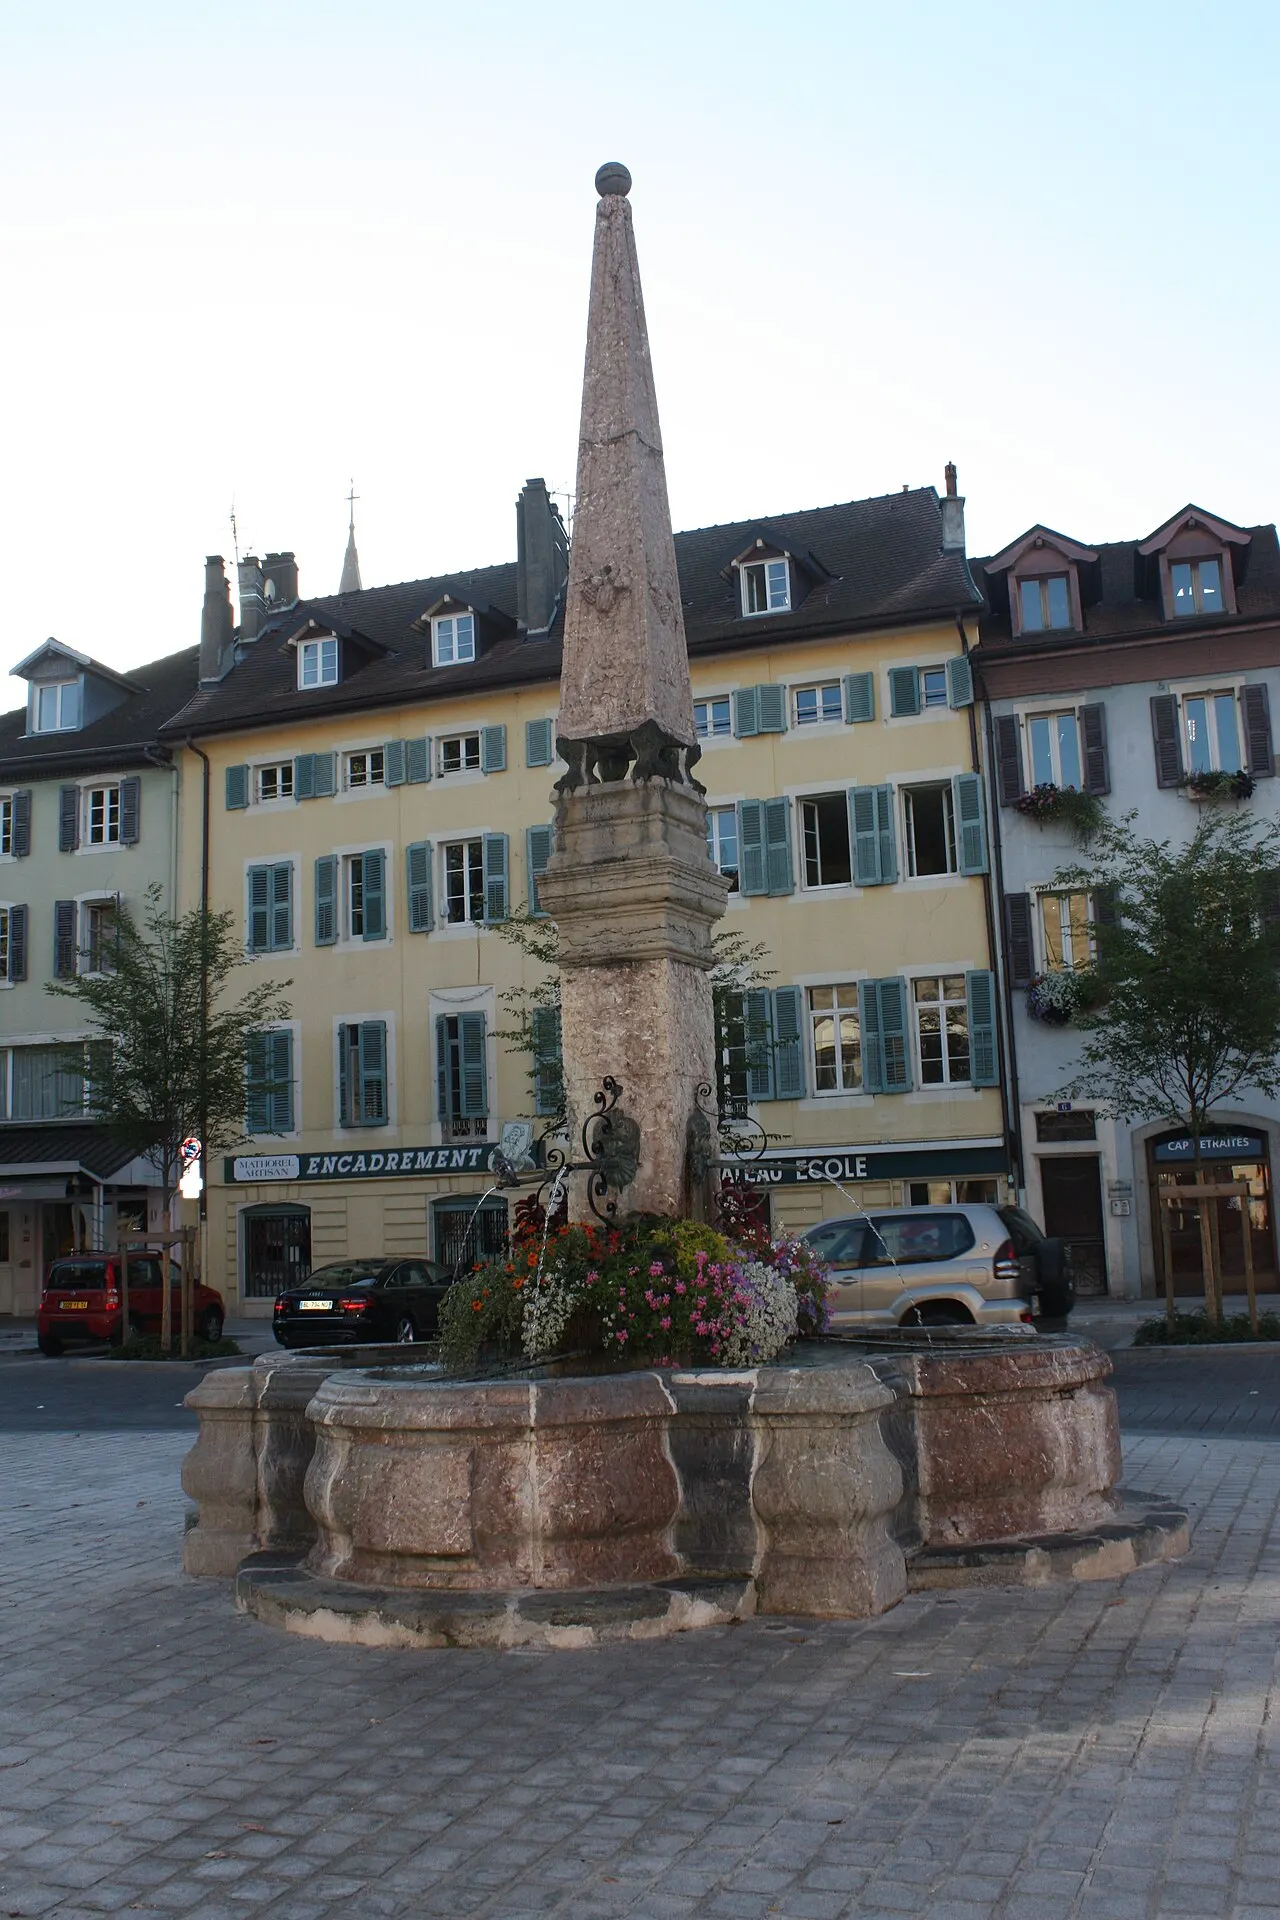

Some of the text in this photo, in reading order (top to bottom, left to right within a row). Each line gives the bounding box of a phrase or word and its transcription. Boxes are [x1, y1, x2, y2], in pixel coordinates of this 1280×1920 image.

[1168, 1137, 1250, 1151] CAP ETRAITES
[306, 1149, 482, 1175] ENCADREMENT
[796, 1157, 867, 1180] ECOLE
[243, 1168, 289, 1178] ARTISAN
